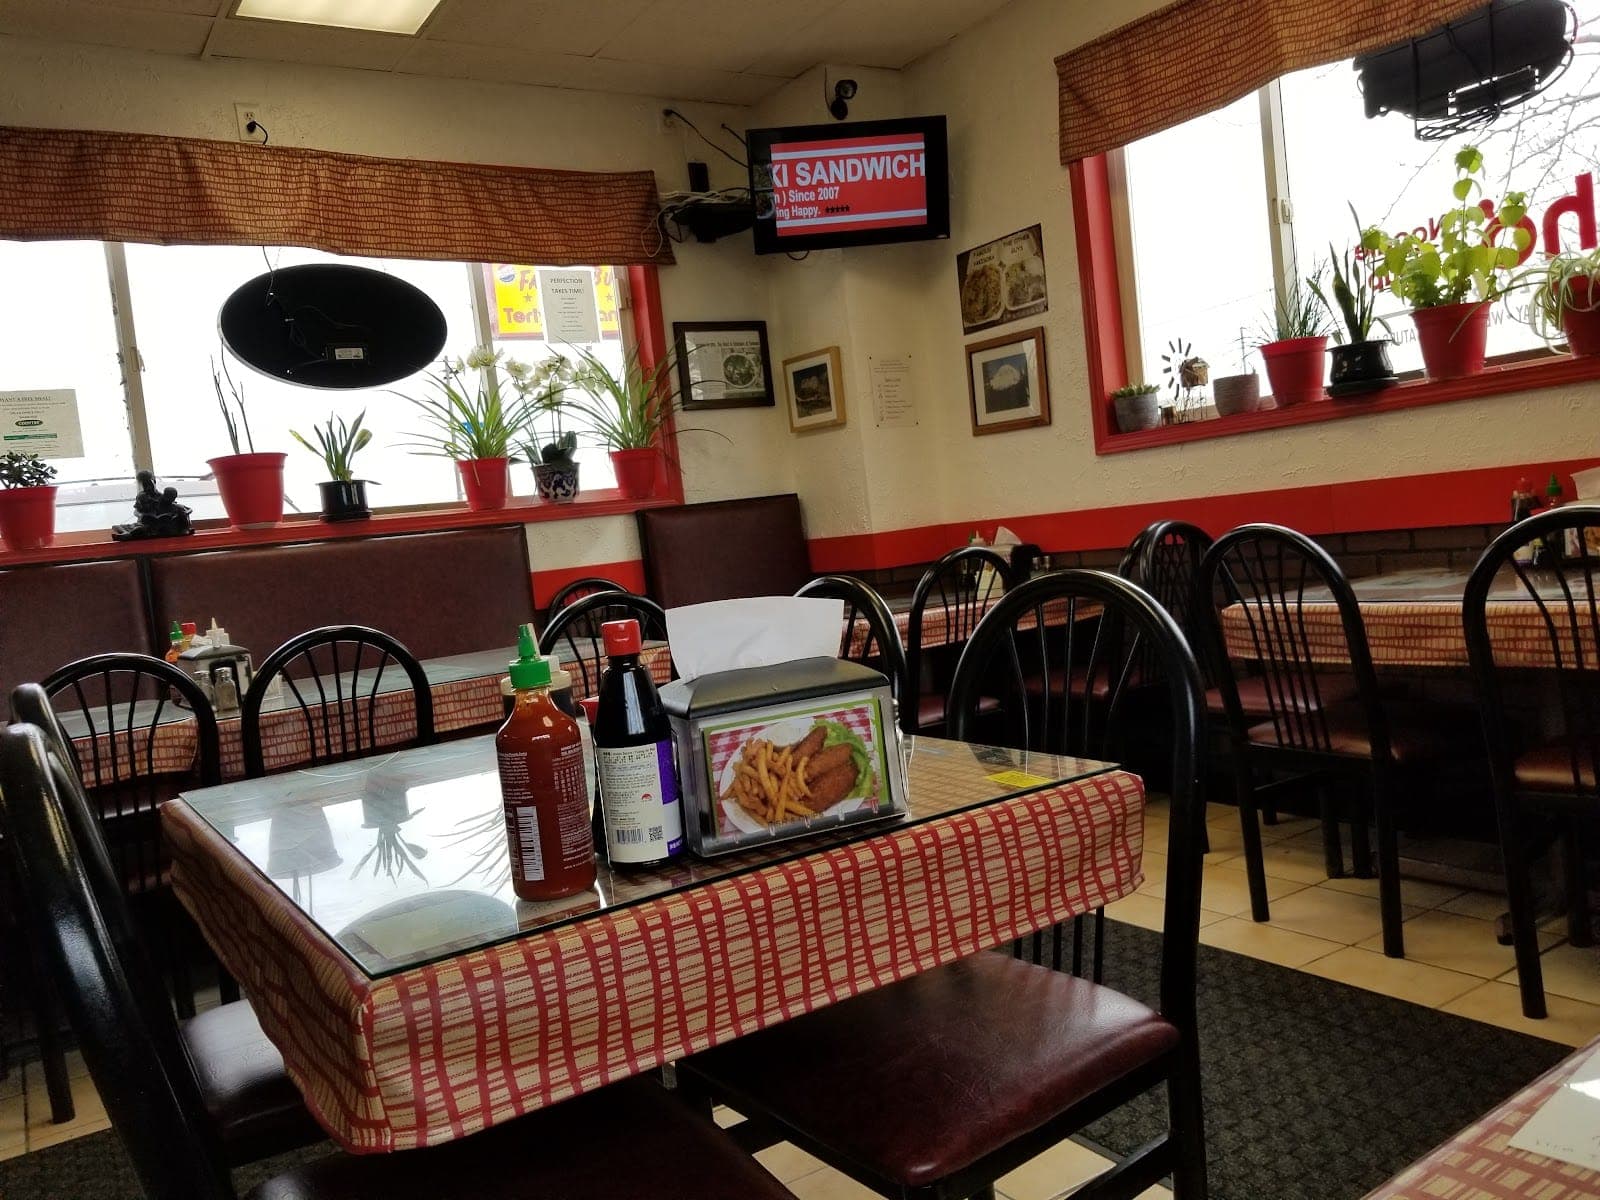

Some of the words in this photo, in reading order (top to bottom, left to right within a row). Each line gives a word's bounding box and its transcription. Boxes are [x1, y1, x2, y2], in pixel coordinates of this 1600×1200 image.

[795, 152, 926, 188] SANDWICH
[788, 189, 816, 203] Since
[817, 186, 840, 201] 2007
[791, 204, 821, 218] Happy.
